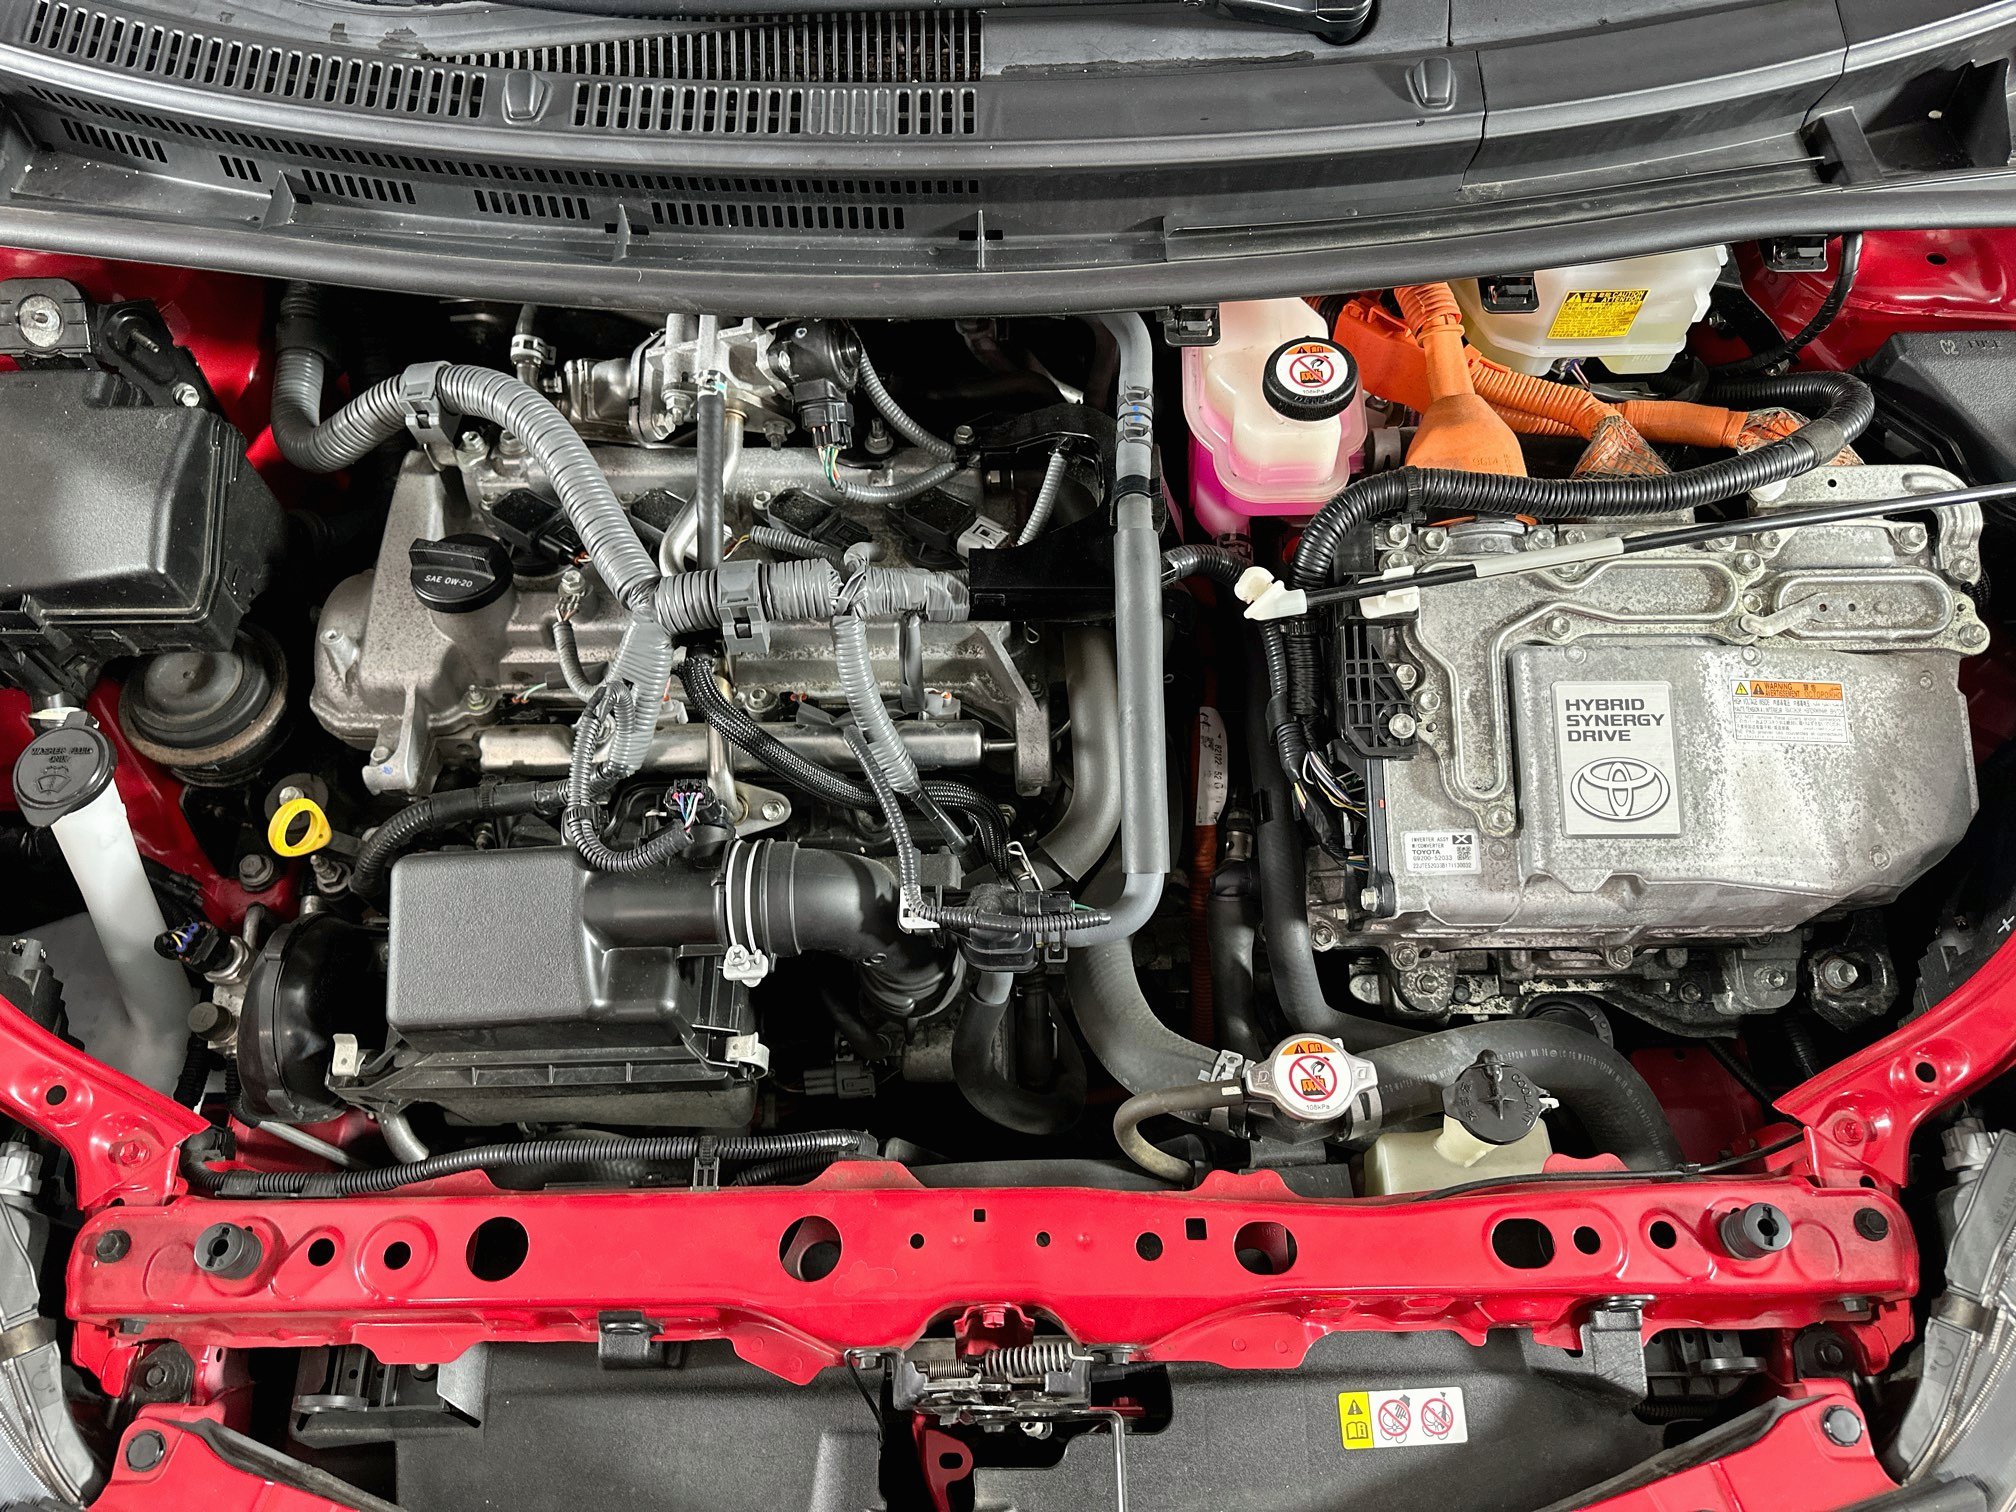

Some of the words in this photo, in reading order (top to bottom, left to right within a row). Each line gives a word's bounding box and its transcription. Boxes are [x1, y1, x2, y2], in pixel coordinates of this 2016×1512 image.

[424, 574, 443, 583] SAE
[444, 577, 473, 588] 0W-20
[1764, 682, 1793, 690] WARNING
[1765, 689, 1800, 697] AVERTISSEMENT
[1565, 698, 1645, 711] HYBRID
[1566, 713, 1665, 727] SYNERGY
[1567, 729, 1632, 742] DRIVE
[1511, 1073, 1535, 1126] COOLANT
